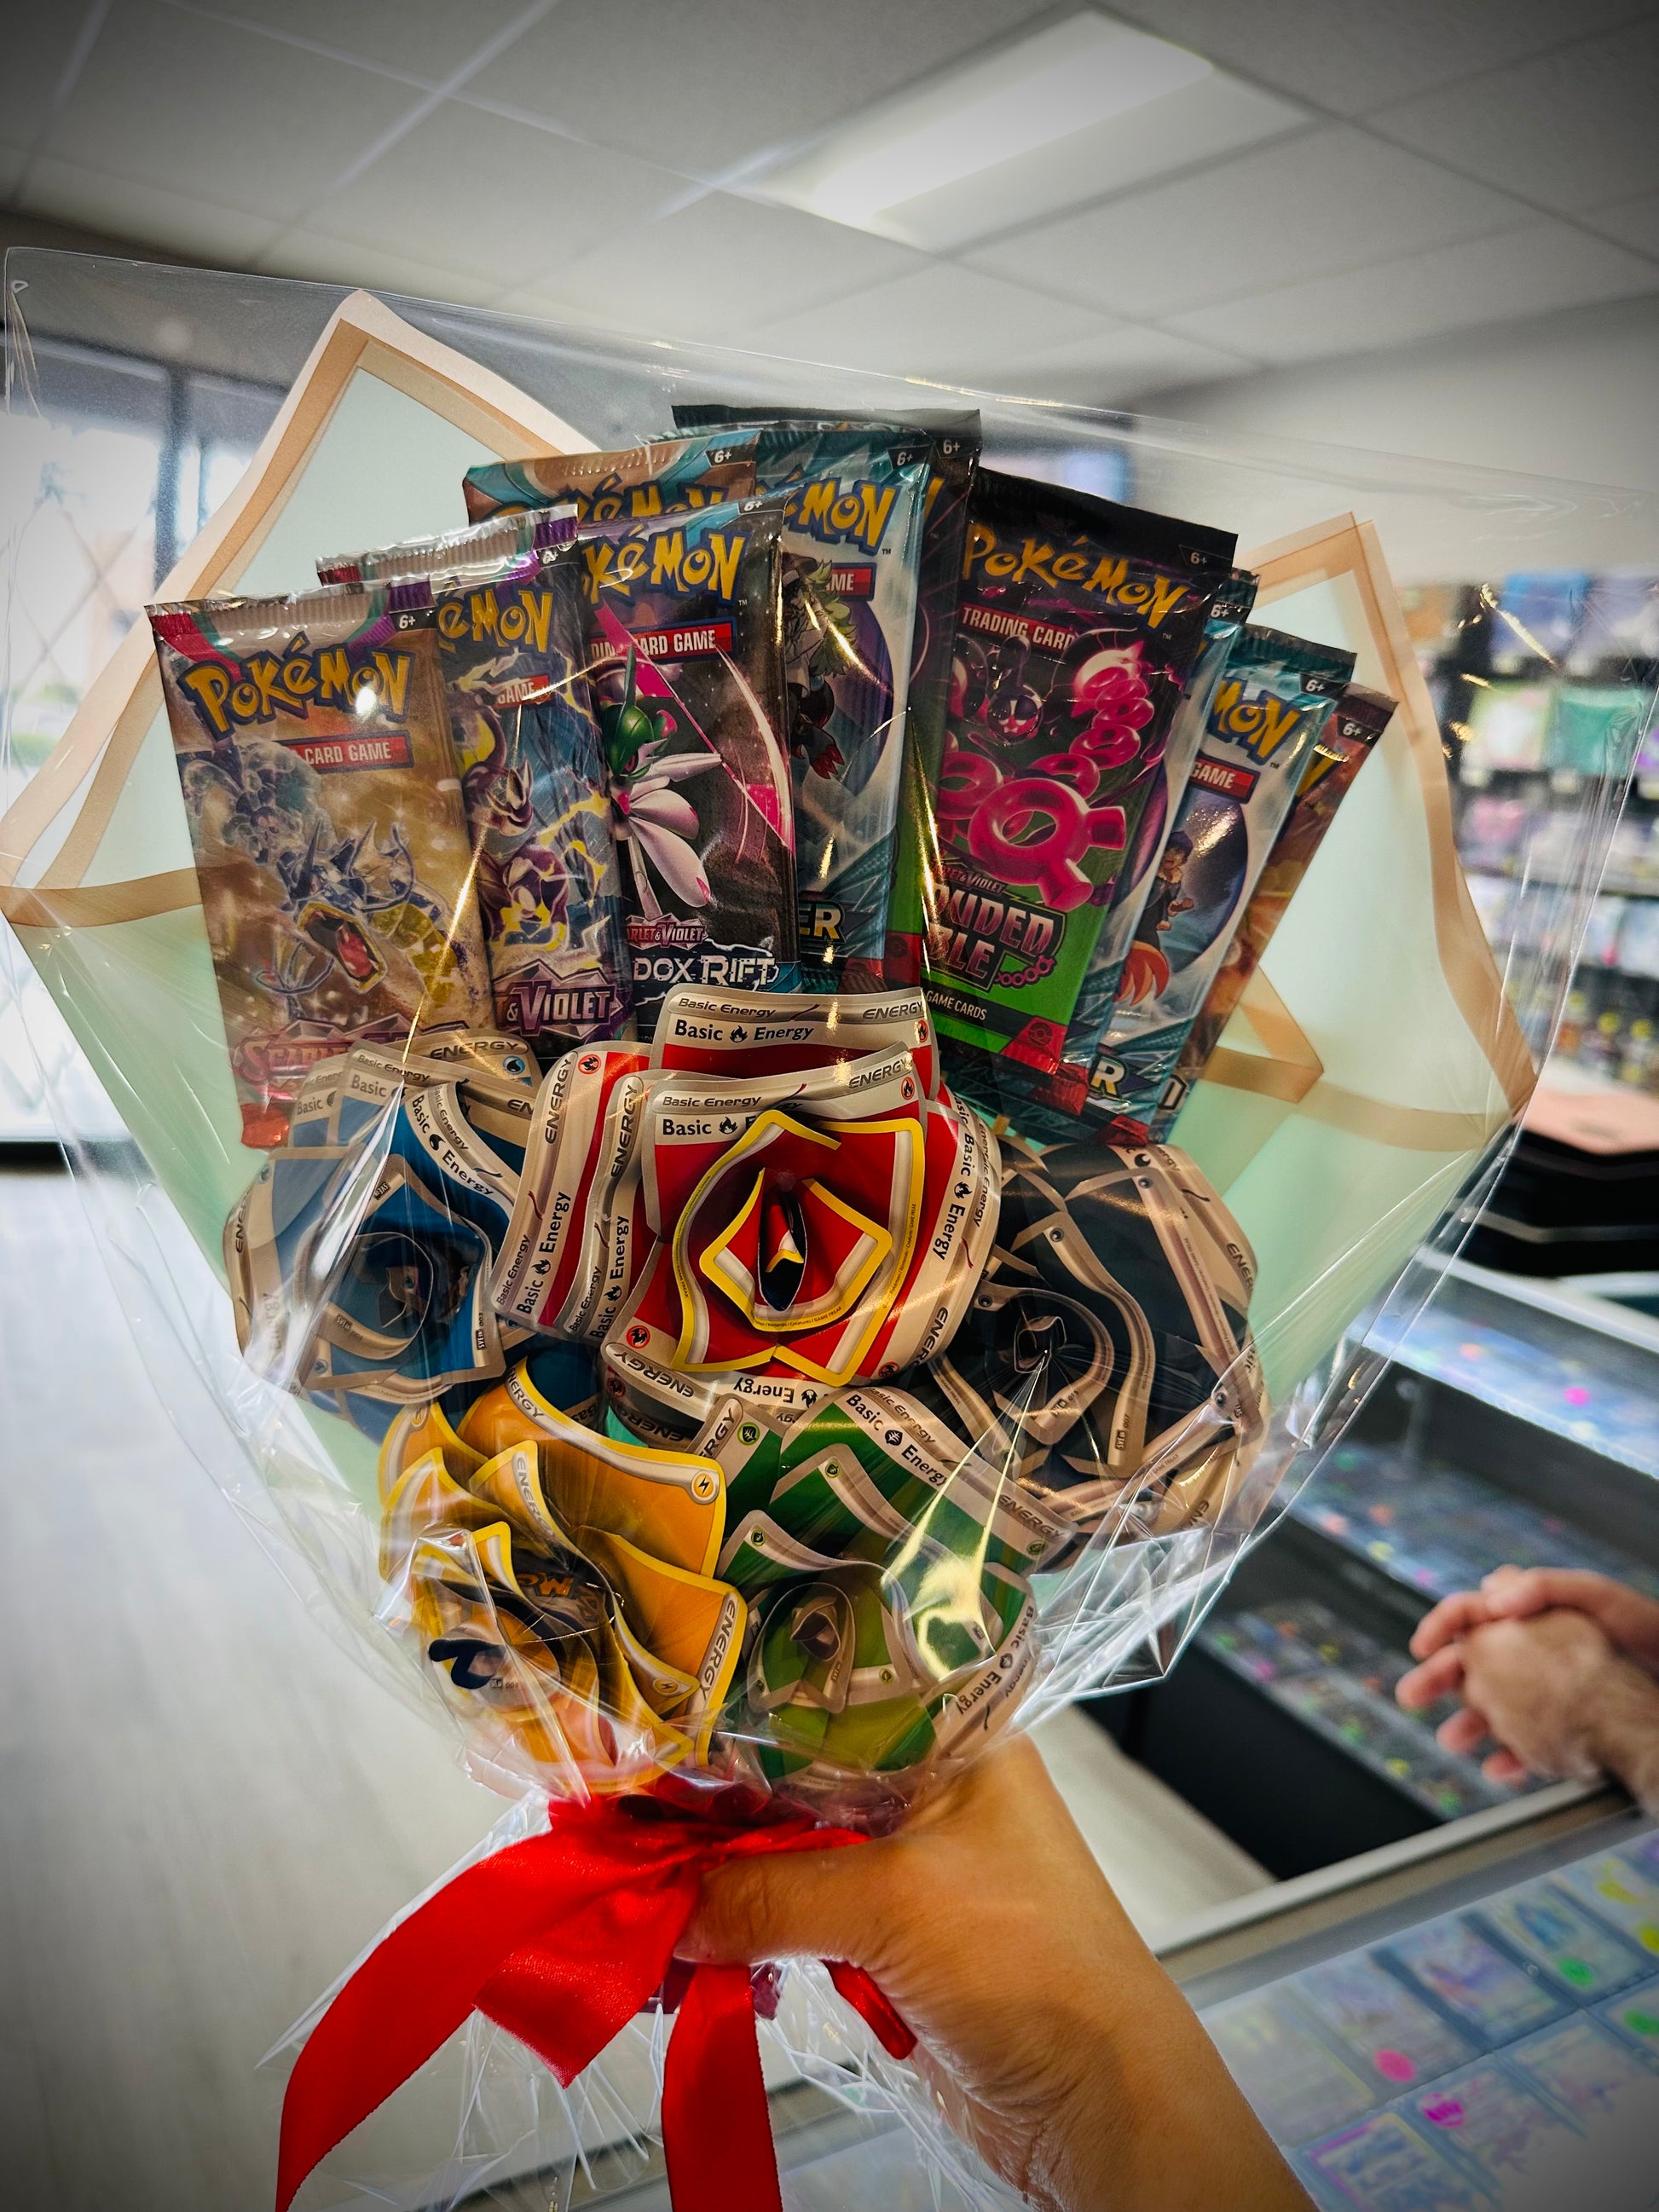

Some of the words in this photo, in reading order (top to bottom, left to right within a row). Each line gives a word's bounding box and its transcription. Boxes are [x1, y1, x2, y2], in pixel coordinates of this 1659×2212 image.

[714, 450, 732, 463] 6+
[896, 450, 914, 465] 6+
[943, 441, 960, 453] 6+
[743, 500, 763, 512] 6+
[1190, 552, 1208, 565] 6+
[398, 615, 416, 630] 6+
[962, 607, 1028, 638] TRADING
[1210, 604, 1229, 618] 6+
[638, 634, 668, 656] ARD
[673, 629, 716, 653] GAME
[1305, 679, 1324, 692] 6+
[1342, 723, 1361, 736] 6+
[304, 744, 344, 765] CARD
[349, 742, 391, 762] GAME
[928, 923, 996, 979] BLE
[701, 955, 776, 986] RIFT
[518, 984, 611, 1036] VIOLET
[678, 997, 718, 1014] Basic
[718, 1003, 777, 1019] Energy
[862, 1000, 923, 1020] ENERGY
[926, 990, 955, 1013] GAME
[954, 997, 988, 1021] CARDS
[674, 1019, 724, 1042] Basic
[754, 1025, 815, 1042] Energy
[357, 1054, 383, 1069] Basic
[431, 1040, 519, 1060] ENERGY
[350, 1074, 387, 1098] Basic
[662, 1096, 700, 1108] Basic
[703, 1096, 761, 1108] Energy
[848, 1056, 911, 1089] ENERGY
[545, 1057, 574, 1145] ENERGY
[953, 1095, 969, 1127] asic
[439, 1109, 469, 1151] Energy
[610, 1083, 639, 1179] ENERGY
[662, 1118, 712, 1136] Basic
[412, 1094, 431, 1135] Basic
[442, 1150, 494, 1195] Energy
[960, 1133, 975, 1177] Basic
[973, 1177, 991, 1228] Energy
[933, 1203, 966, 1262] Energy
[516, 1279, 544, 1314] Basic
[546, 1192, 572, 1254] Energy
[496, 1279, 513, 1305] Basic
[507, 1233, 531, 1279] Energy
[588, 1306, 616, 1338] Basic
[610, 1216, 630, 1280] Energy
[569, 1310, 587, 1331] Basic
[581, 1266, 602, 1310] Energy
[614, 1351, 695, 1398] ENERGY
[733, 1377, 795, 1404] Energy
[894, 1405, 936, 1445] Energy
[846, 1394, 885, 1432] Basic
[997, 1493, 1064, 1539] ENERGY
[1010, 1605, 1035, 1649] Basic
[699, 1599, 738, 1701] ENERGY
[955, 1670, 1003, 1715] Energy
